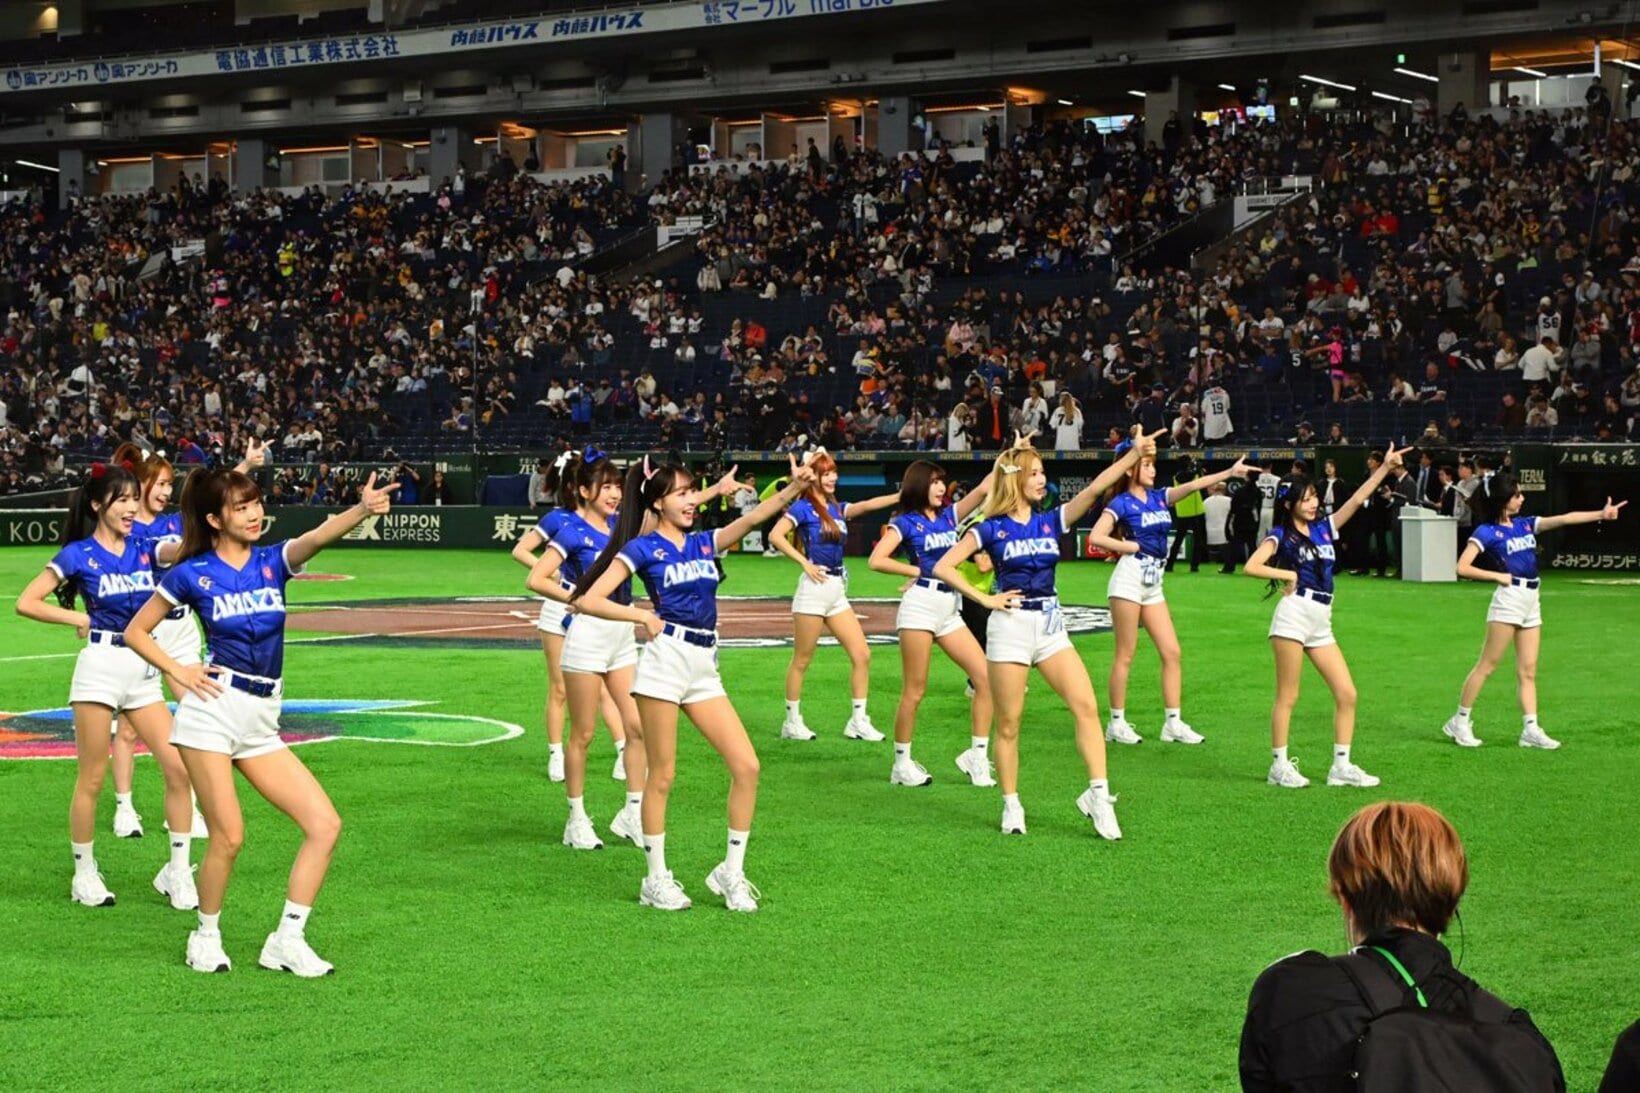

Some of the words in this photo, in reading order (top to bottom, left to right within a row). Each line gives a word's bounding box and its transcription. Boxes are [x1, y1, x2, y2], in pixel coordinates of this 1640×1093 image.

[552, 11, 645, 36] 内藤ハウス
[451, 22, 540, 46] 内藤ハウス
[216, 35, 400, 71] 電協通信工業株式会社
[1212, 402, 1224, 415] 19
[383, 514, 440, 528] NIPPON
[383, 528, 440, 542] EXPRESS
